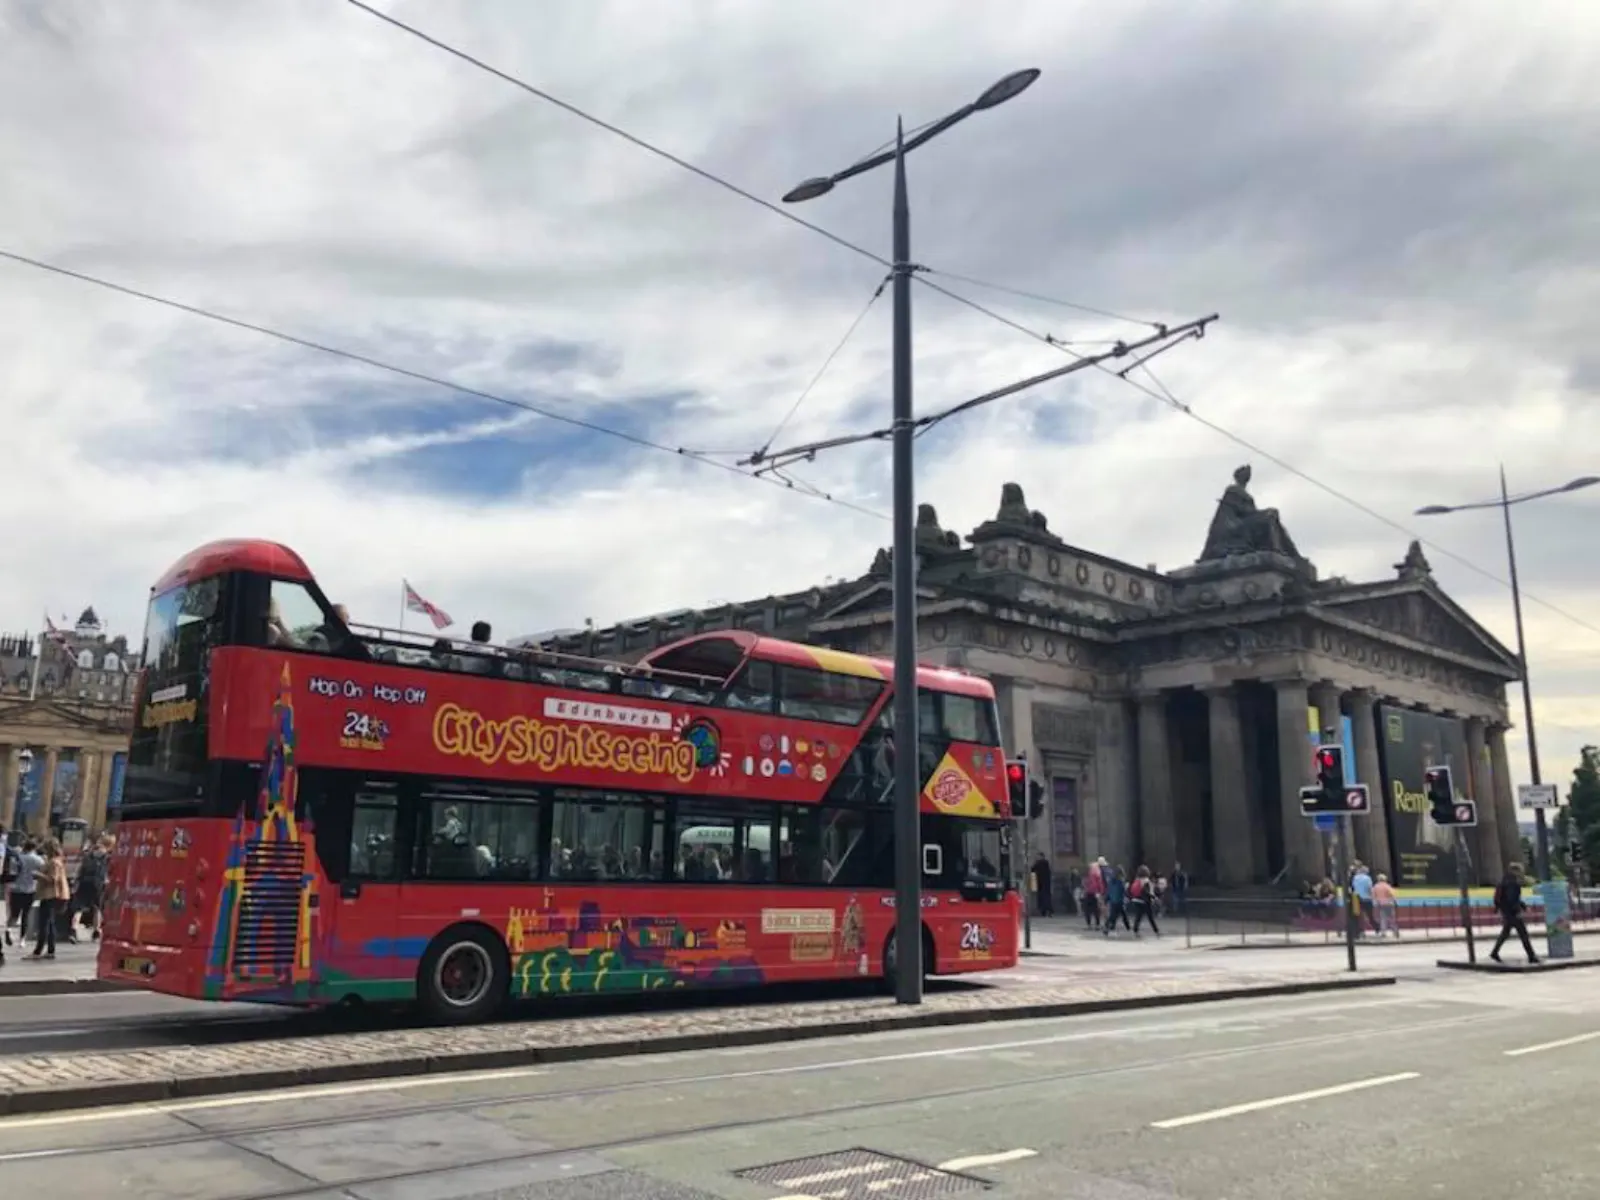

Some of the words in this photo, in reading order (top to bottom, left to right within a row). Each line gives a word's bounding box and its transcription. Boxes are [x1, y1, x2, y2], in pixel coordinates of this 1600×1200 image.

[308, 677, 339, 697] Hop
[343, 679, 363, 698] On
[373, 684, 401, 702] Hop
[404, 687, 426, 704] Off
[343, 711, 370, 736] 24
[557, 701, 662, 724] Edinburgh
[433, 702, 697, 784] CitySightseeing
[960, 922, 981, 948] 24
